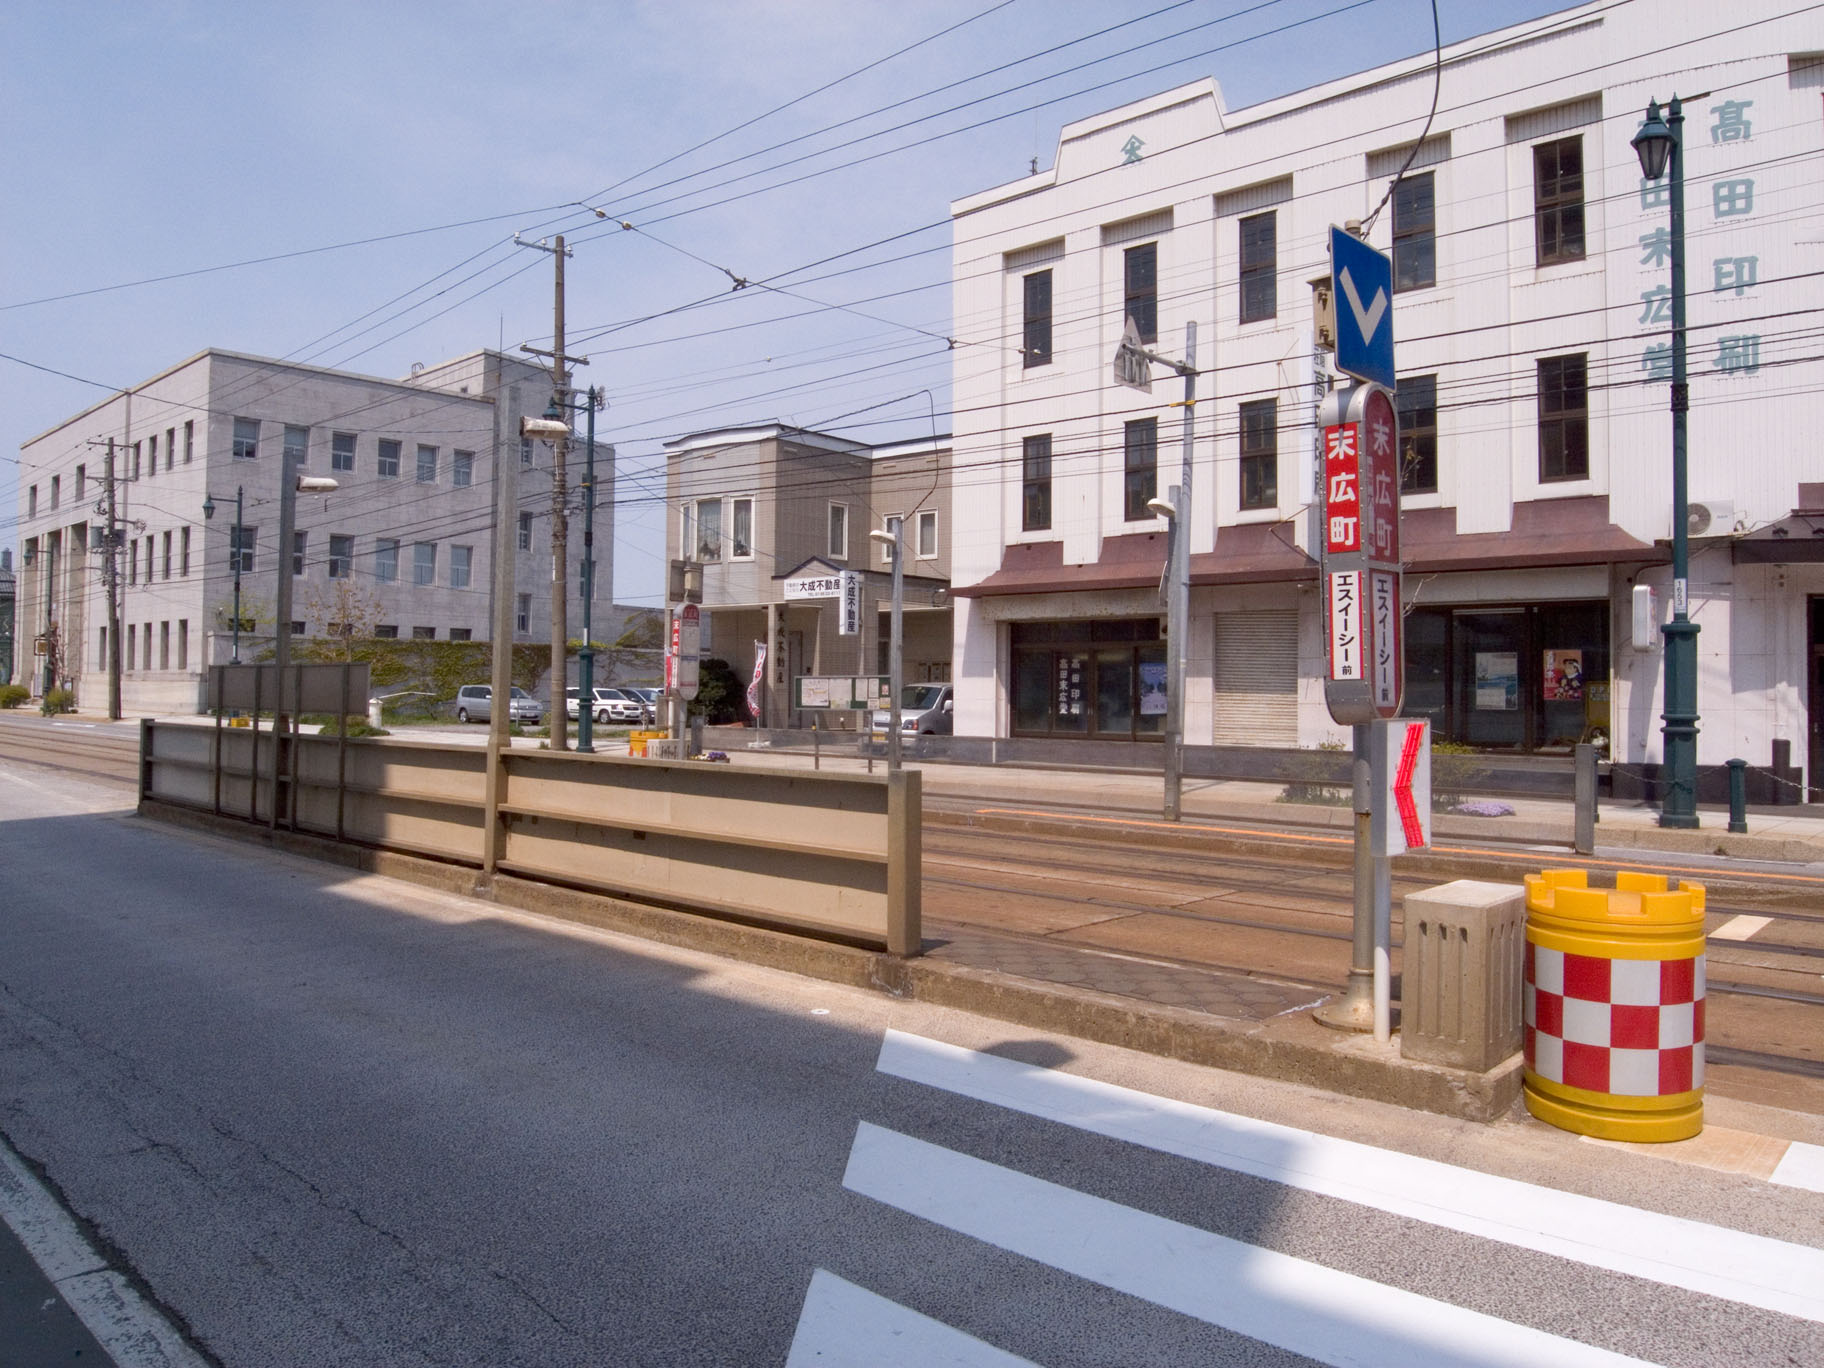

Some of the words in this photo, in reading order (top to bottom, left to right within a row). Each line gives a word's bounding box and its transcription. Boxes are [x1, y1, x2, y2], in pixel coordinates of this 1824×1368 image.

[1638, 114, 1673, 385] 田末広堂
[1327, 428, 1357, 546] 末広町
[1373, 418, 1393, 557] 末広町
[799, 579, 840, 592] 大成不動産
[848, 574, 856, 632] 大成不動産
[1337, 574, 1355, 676] エスイーシー前
[1377, 579, 1390, 702] エスイーシー前
